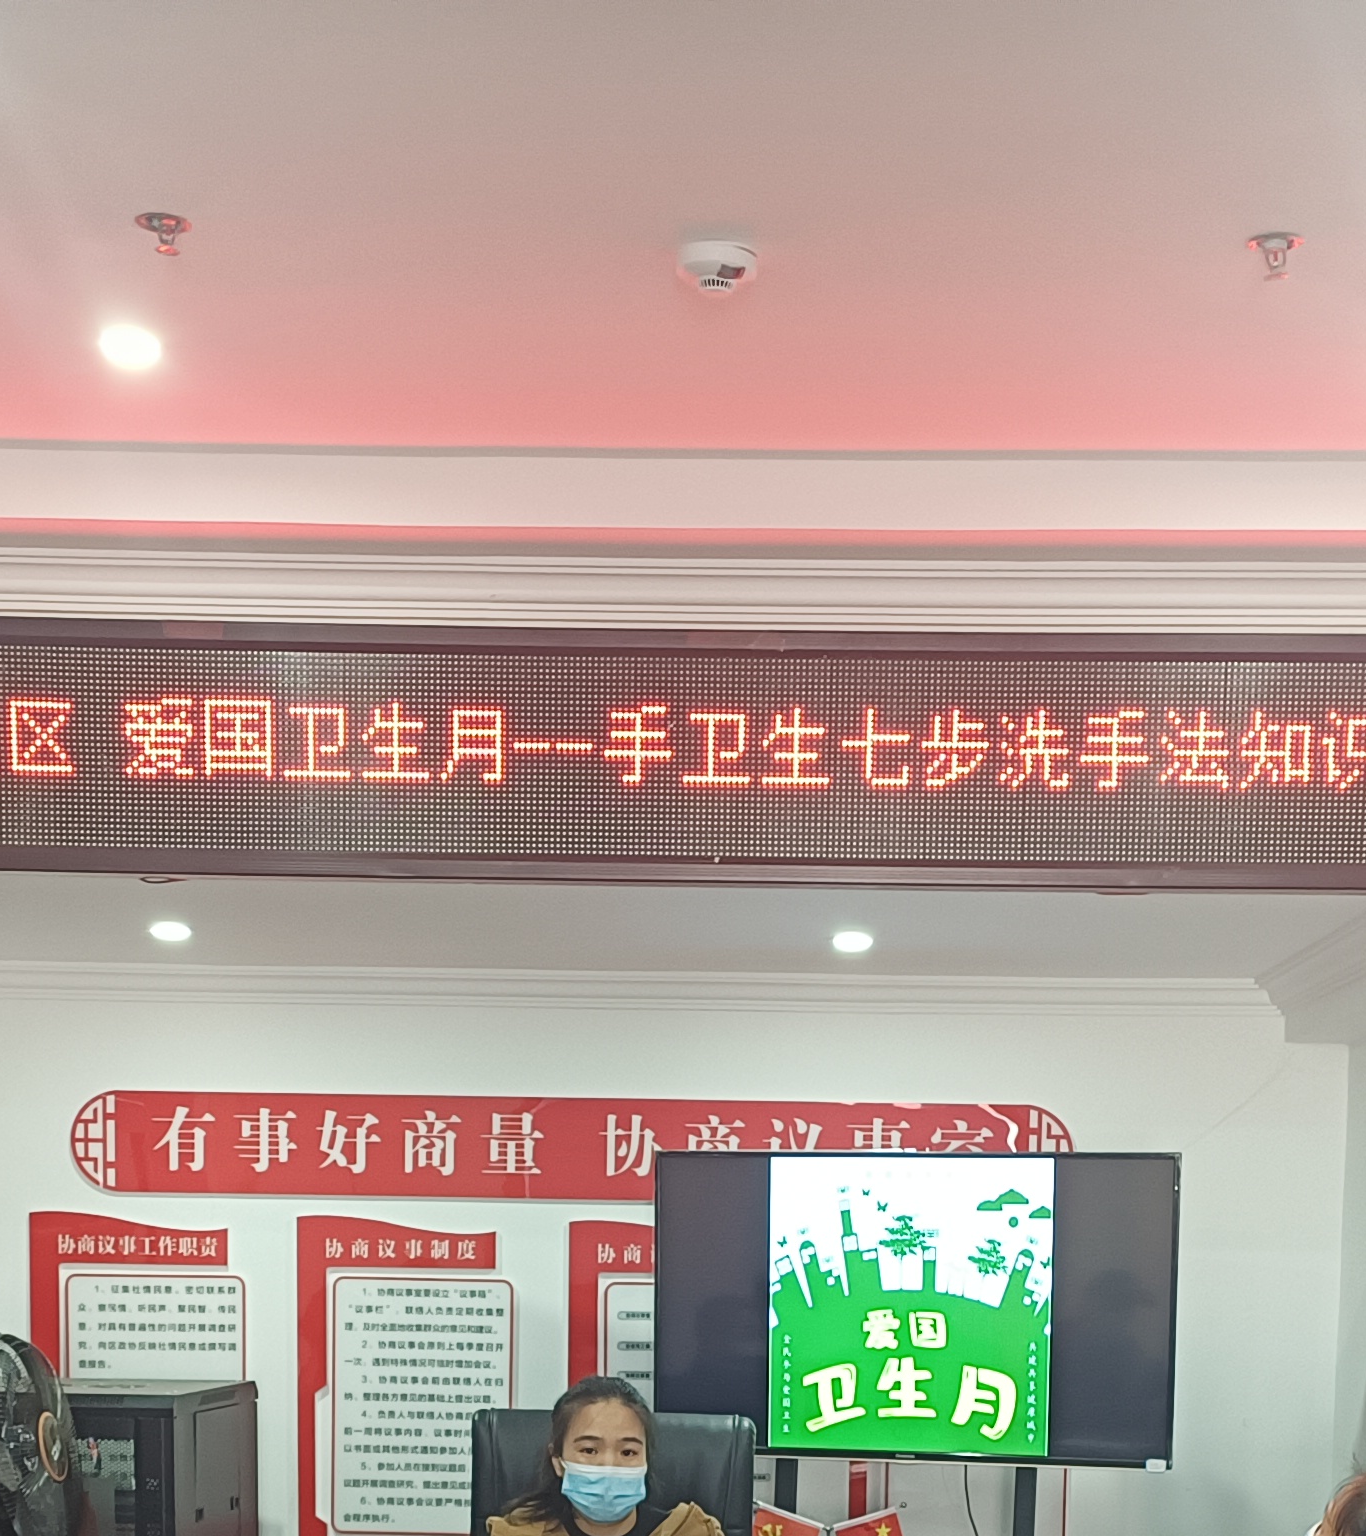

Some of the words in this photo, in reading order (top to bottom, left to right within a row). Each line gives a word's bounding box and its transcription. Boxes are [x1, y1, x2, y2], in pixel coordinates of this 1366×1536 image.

[155, 1107, 543, 1176] 有事好商量
[58, 1234, 218, 1257] 协商议事工作职责
[325, 1238, 477, 1260] 协商议事制度
[598, 1243, 654, 1265] 协商
[863, 1308, 947, 1350] 爱国
[802, 1357, 1018, 1440] 卫生月
